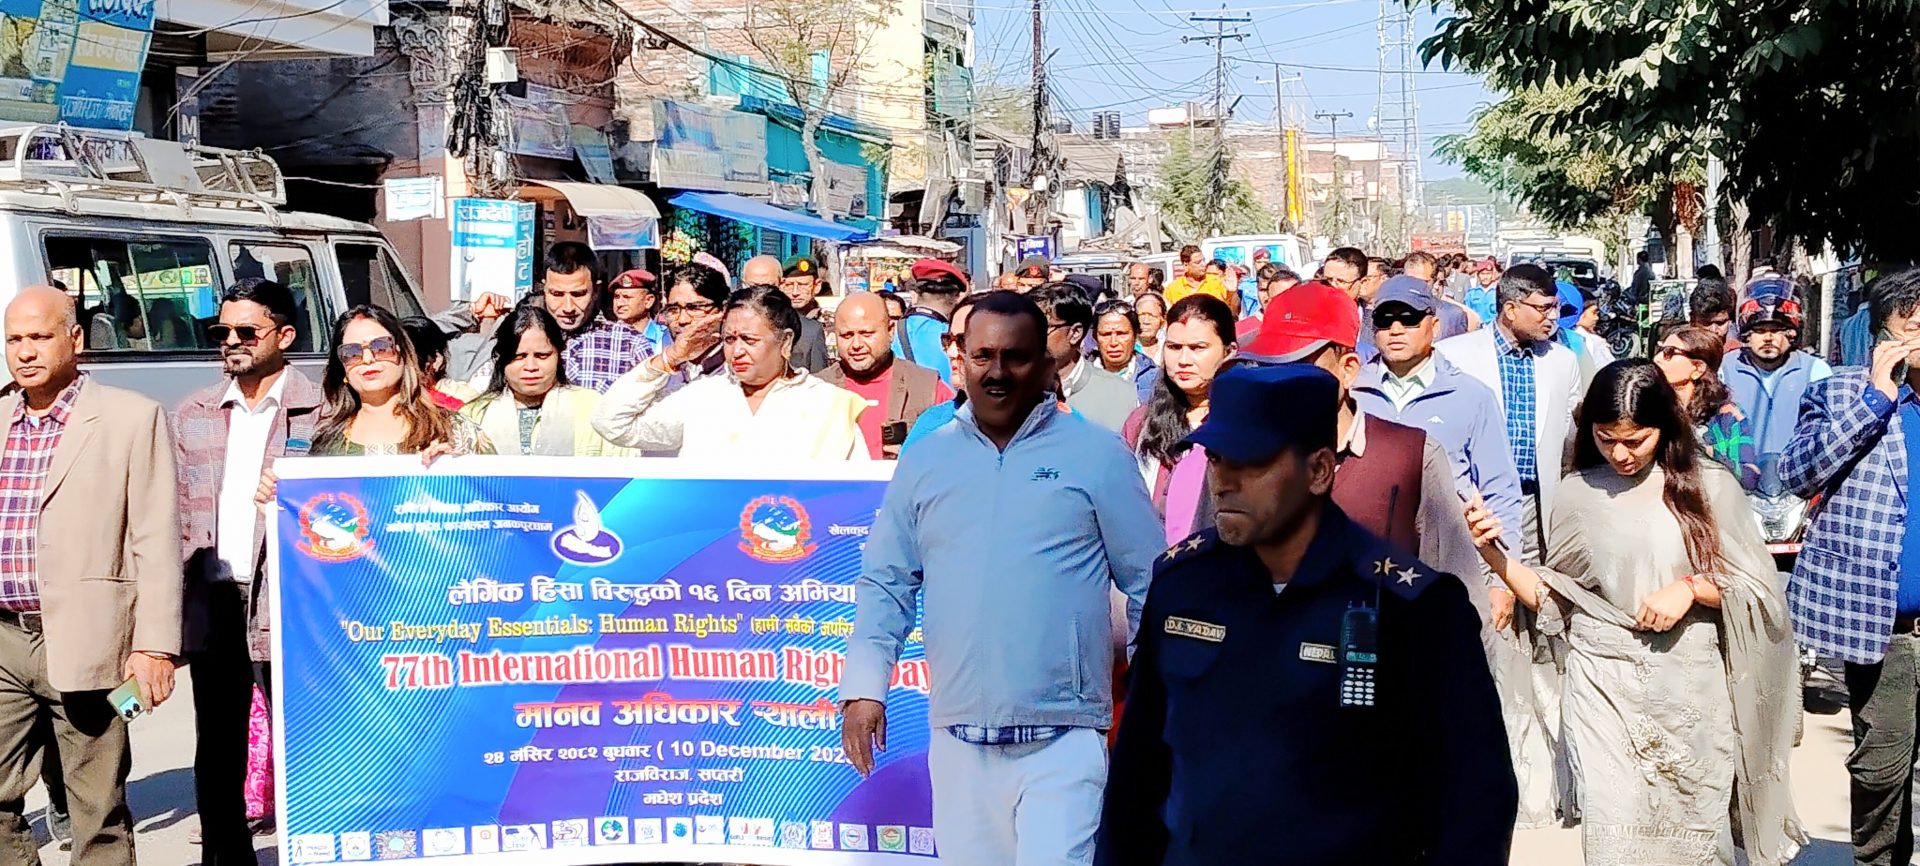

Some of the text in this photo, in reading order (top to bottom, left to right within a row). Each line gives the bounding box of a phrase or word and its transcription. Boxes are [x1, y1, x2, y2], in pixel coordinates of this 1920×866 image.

[531, 575, 585, 603] हिंसा
[688, 584, 720, 603] १६
[726, 578, 773, 602] दिन
[778, 579, 857, 604] अभिया
[341, 618, 385, 643] "Our
[390, 619, 483, 645] Everyday
[487, 612, 594, 638] Essentials:
[599, 613, 673, 634] Human
[673, 613, 744, 638] Rights"
[1187, 622, 1224, 639] YADAV
[382, 655, 451, 688] 77th
[459, 646, 663, 685] International
[670, 647, 776, 679] Human
[784, 648, 846, 689] Righ
[513, 701, 602, 729] मानव
[612, 692, 742, 728] अधिकार
[509, 746, 554, 763] मंसिर
[557, 747, 599, 761] २०८२
[602, 745, 652, 762] बुधवार
[670, 741, 694, 757] 10
[701, 741, 804, 761] December
[811, 744, 853, 765] 202
[643, 789, 724, 807] मधेश प्रदेश
